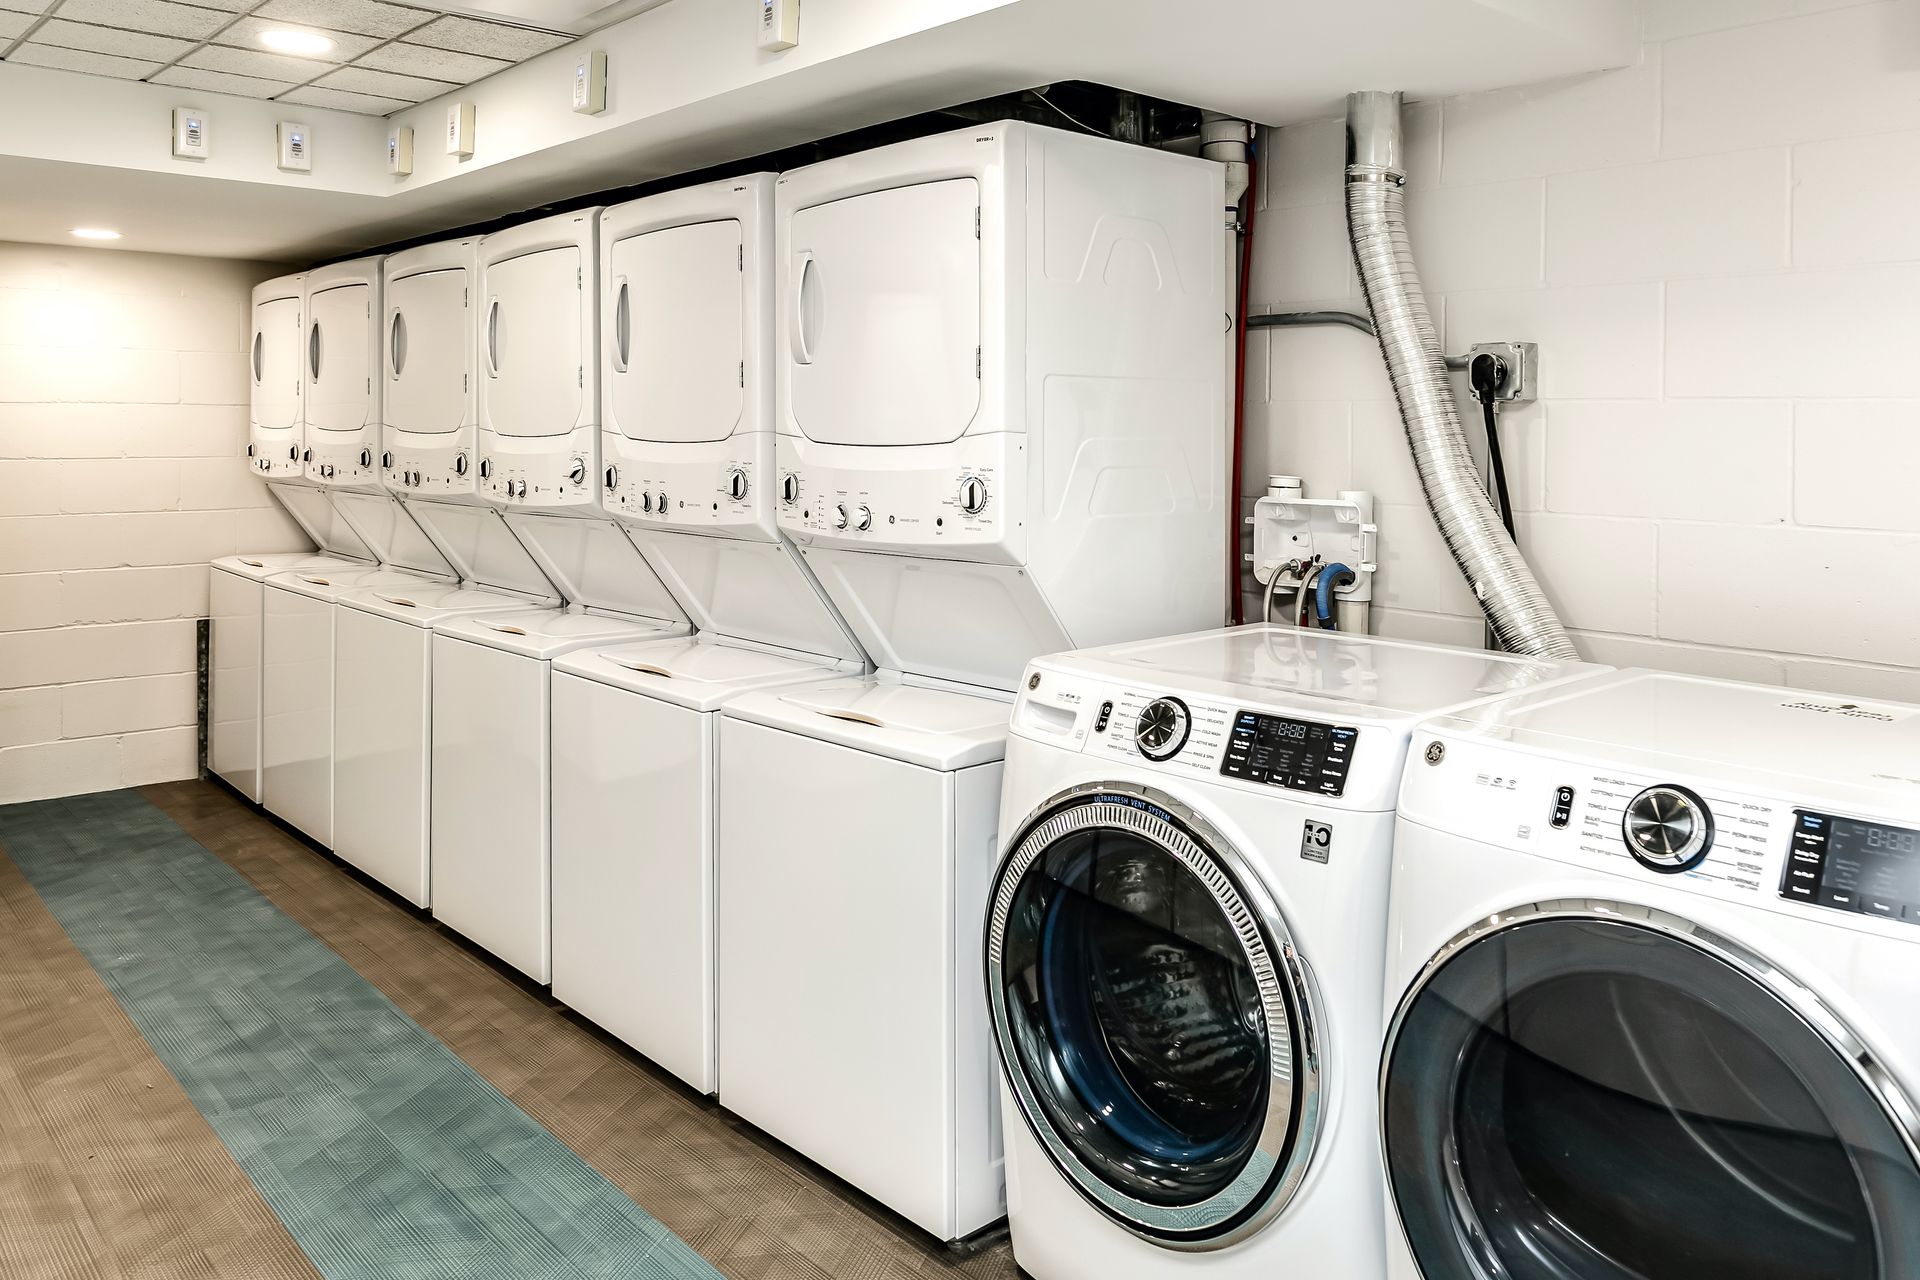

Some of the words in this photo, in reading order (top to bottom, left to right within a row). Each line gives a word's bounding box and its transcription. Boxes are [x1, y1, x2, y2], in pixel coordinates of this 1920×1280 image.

[1094, 795, 1128, 804] ULTRAFRESH
[1130, 799, 1146, 809] VENT
[1148, 805, 1170, 822] SYSTEM
[1305, 824, 1331, 847] 10
